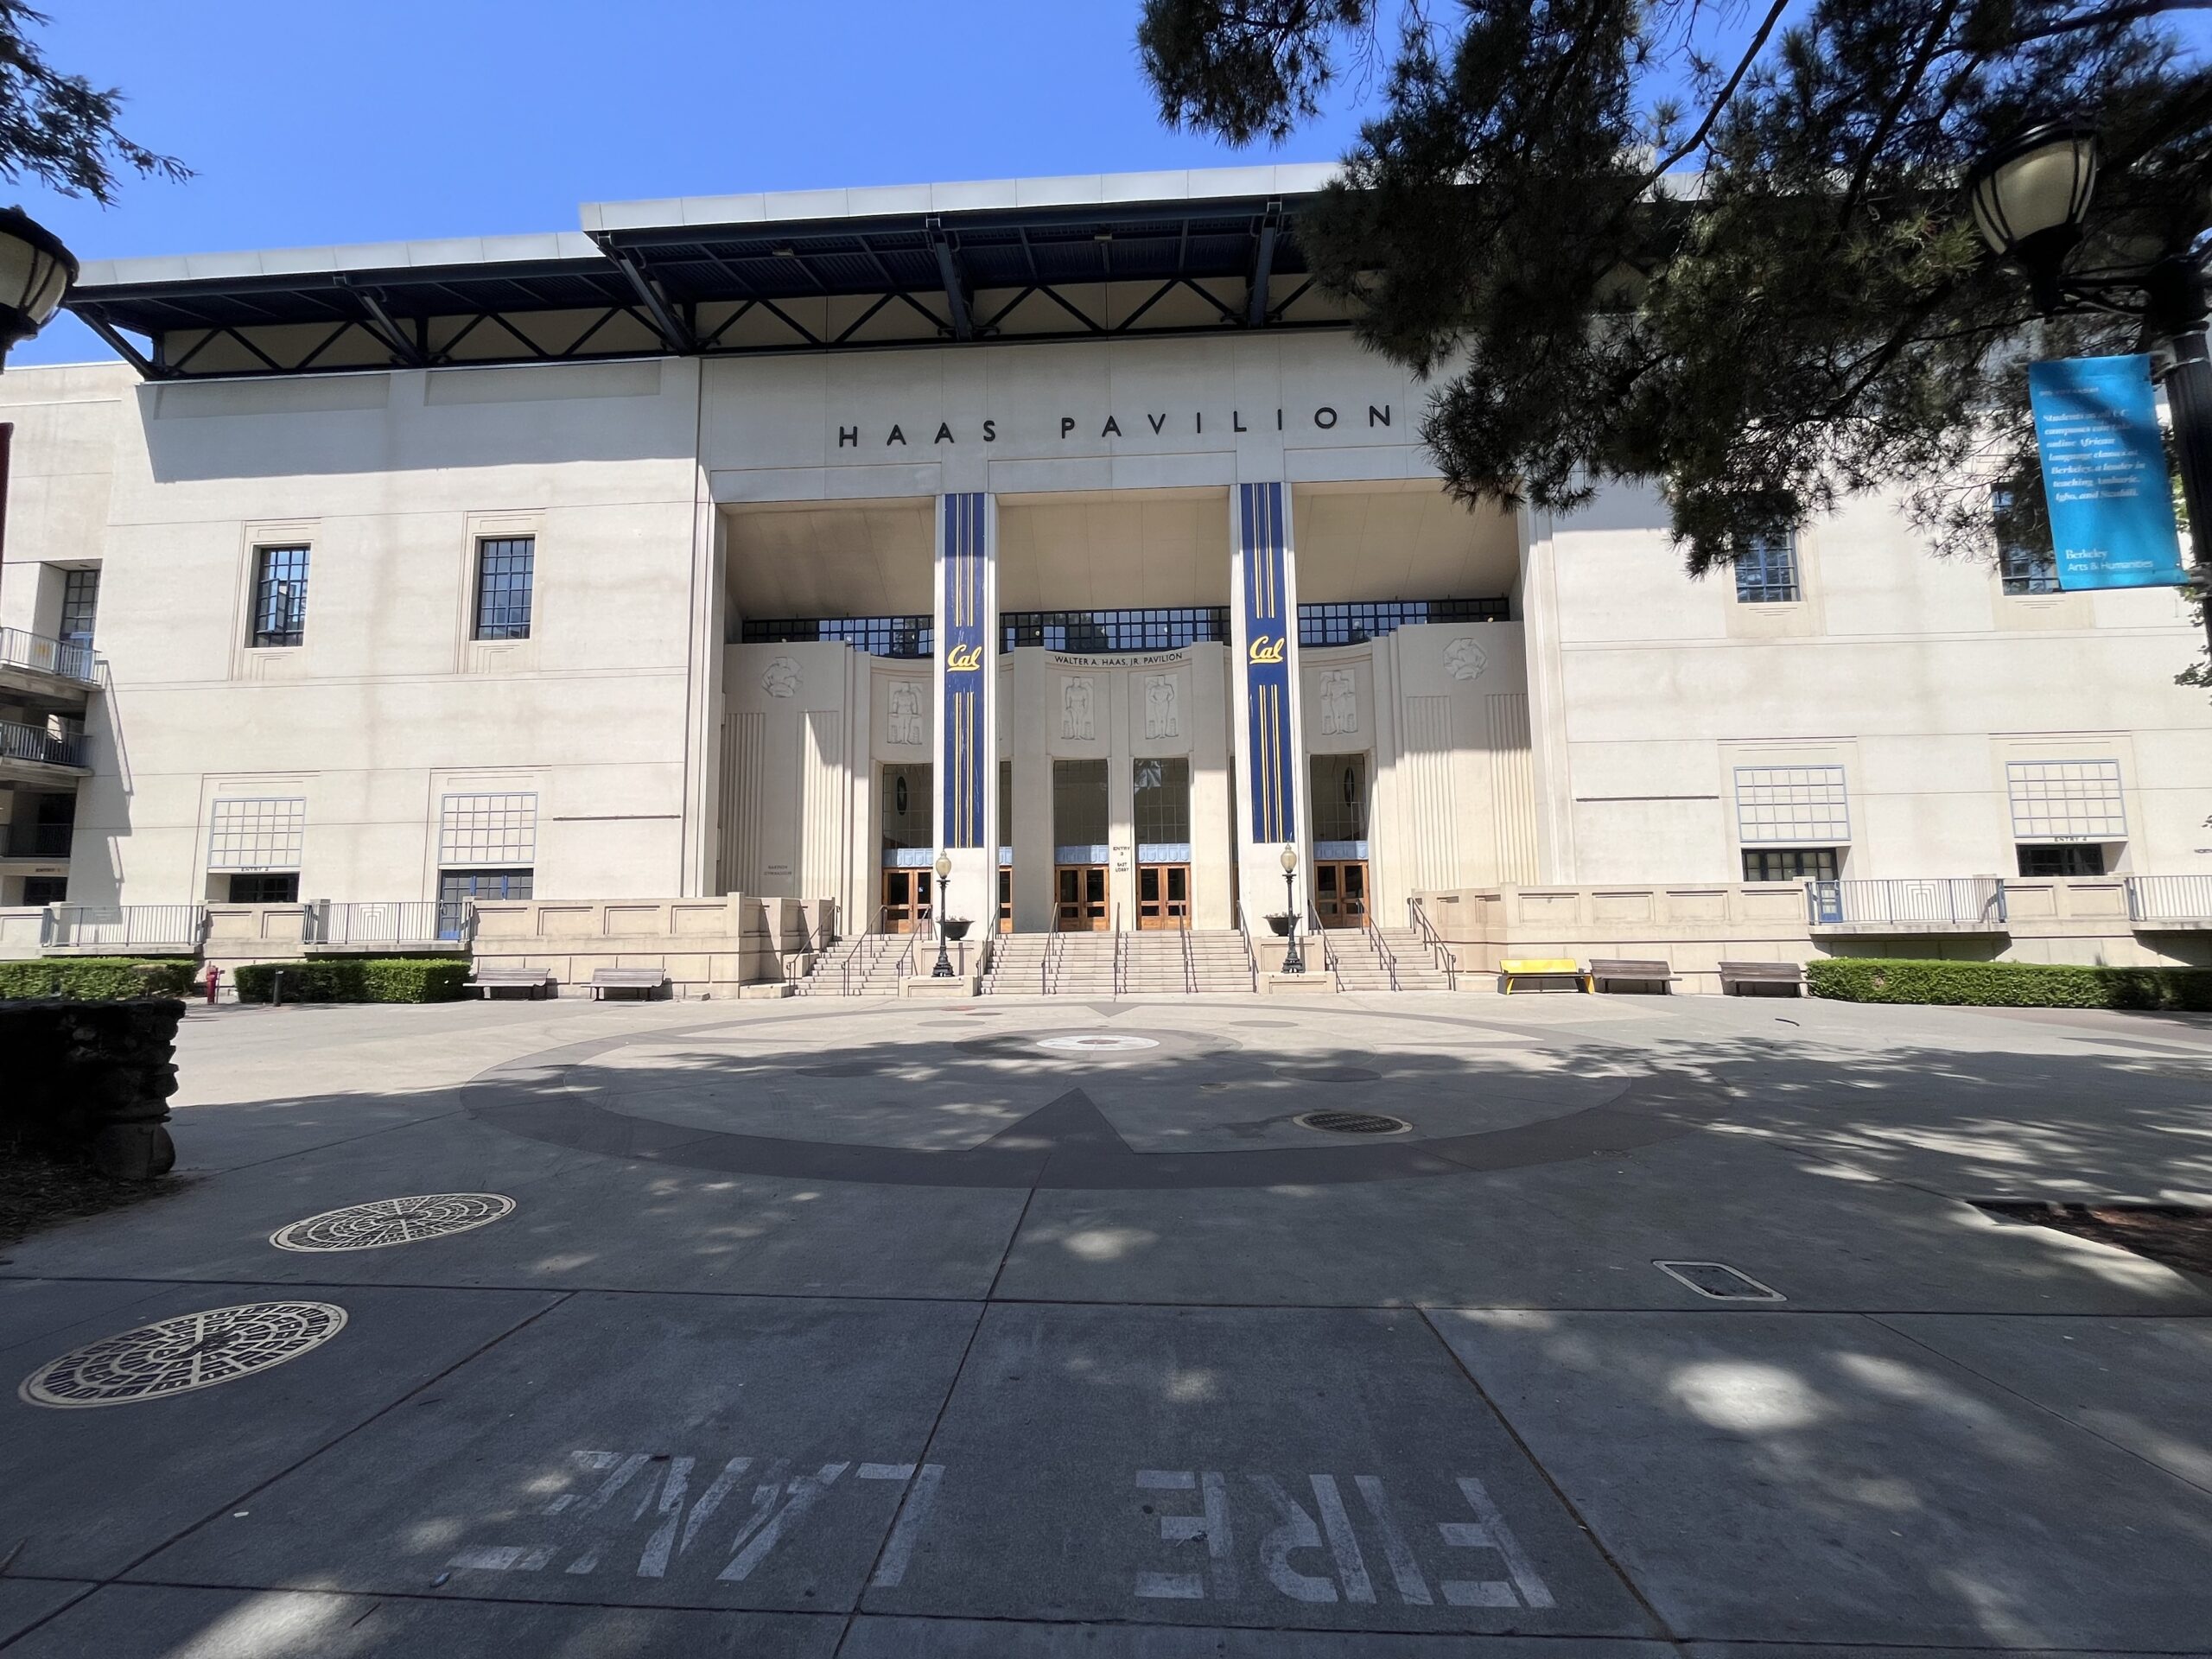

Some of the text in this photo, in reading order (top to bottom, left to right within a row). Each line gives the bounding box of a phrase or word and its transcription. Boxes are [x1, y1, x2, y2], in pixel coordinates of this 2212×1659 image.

[839, 406, 1390, 448] HAAS PAVILION
[2080, 438, 2115, 448] African
[2049, 453, 2093, 462] language
[2103, 462, 2133, 471] leader
[2053, 479, 2094, 488] teaching
[2079, 490, 2100, 499] and
[2065, 549, 2108, 560] Berkeley
[2068, 560, 2153, 571] Arts & Humanities
[1249, 635, 1285, 664] Cal
[947, 644, 982, 673] Cal
[1054, 655, 1088, 665] WALTER
[1144, 652, 1183, 664] PAVILION
[444, 1449, 1556, 1608] FIRE LANE
